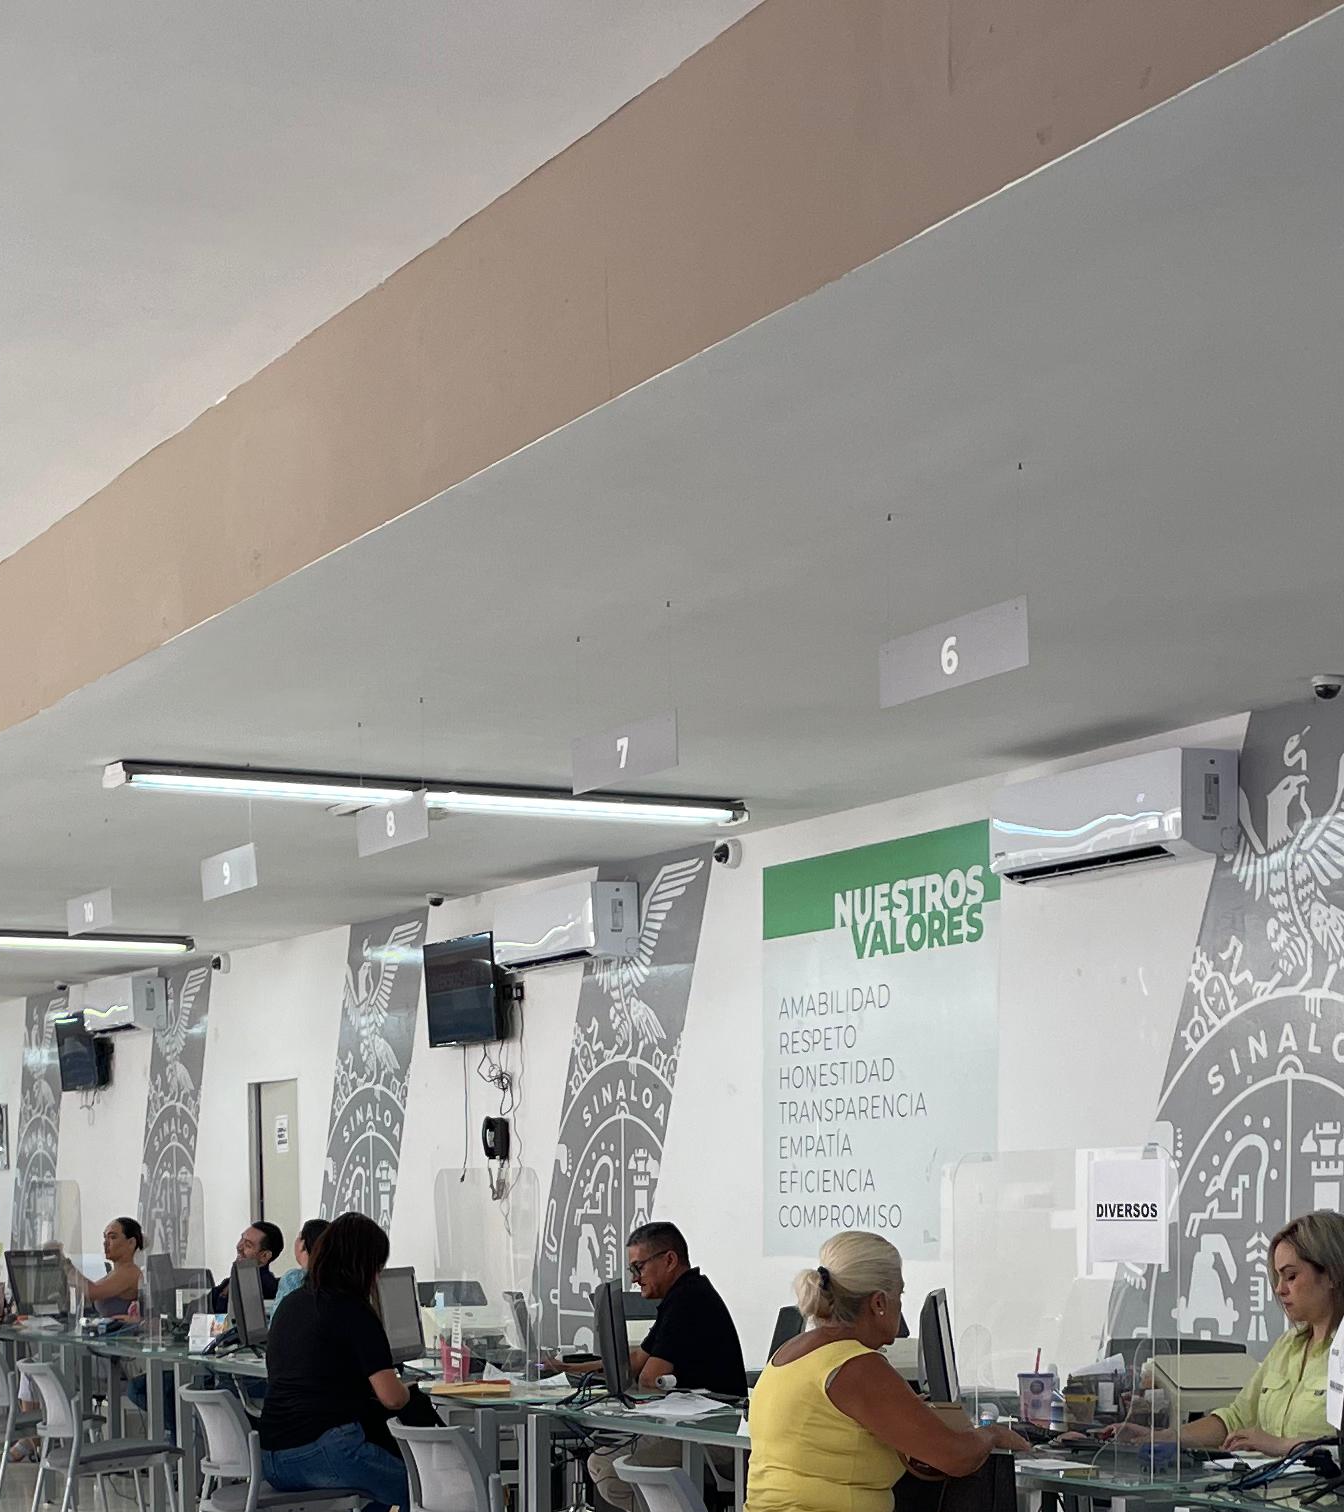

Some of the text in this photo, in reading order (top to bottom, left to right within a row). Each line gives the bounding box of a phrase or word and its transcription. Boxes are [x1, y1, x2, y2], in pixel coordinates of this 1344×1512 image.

[940, 636, 959, 675] 6
[616, 737, 629, 769] 7
[386, 810, 397, 838] 8
[222, 861, 231, 886] 9
[83, 901, 94, 923] 10
[834, 864, 985, 929] NUESTROS
[851, 902, 984, 960] VALORES
[779, 983, 891, 1020] AMABILIDAD
[779, 1024, 857, 1056] RESPETO
[779, 1057, 895, 1090] HONESTIDAD
[582, 1079, 666, 1128] SINALOA
[779, 1091, 928, 1126] TRANSPARENCIA
[153, 1116, 195, 1152] SINALOA
[342, 1102, 401, 1143] SINALOA
[779, 1128, 853, 1160] EMPATÍA
[779, 1168, 876, 1195] EFICIENCIA
[778, 1203, 903, 1230] COMPROMISO
[1096, 1203, 1158, 1218] DIVERSOS
